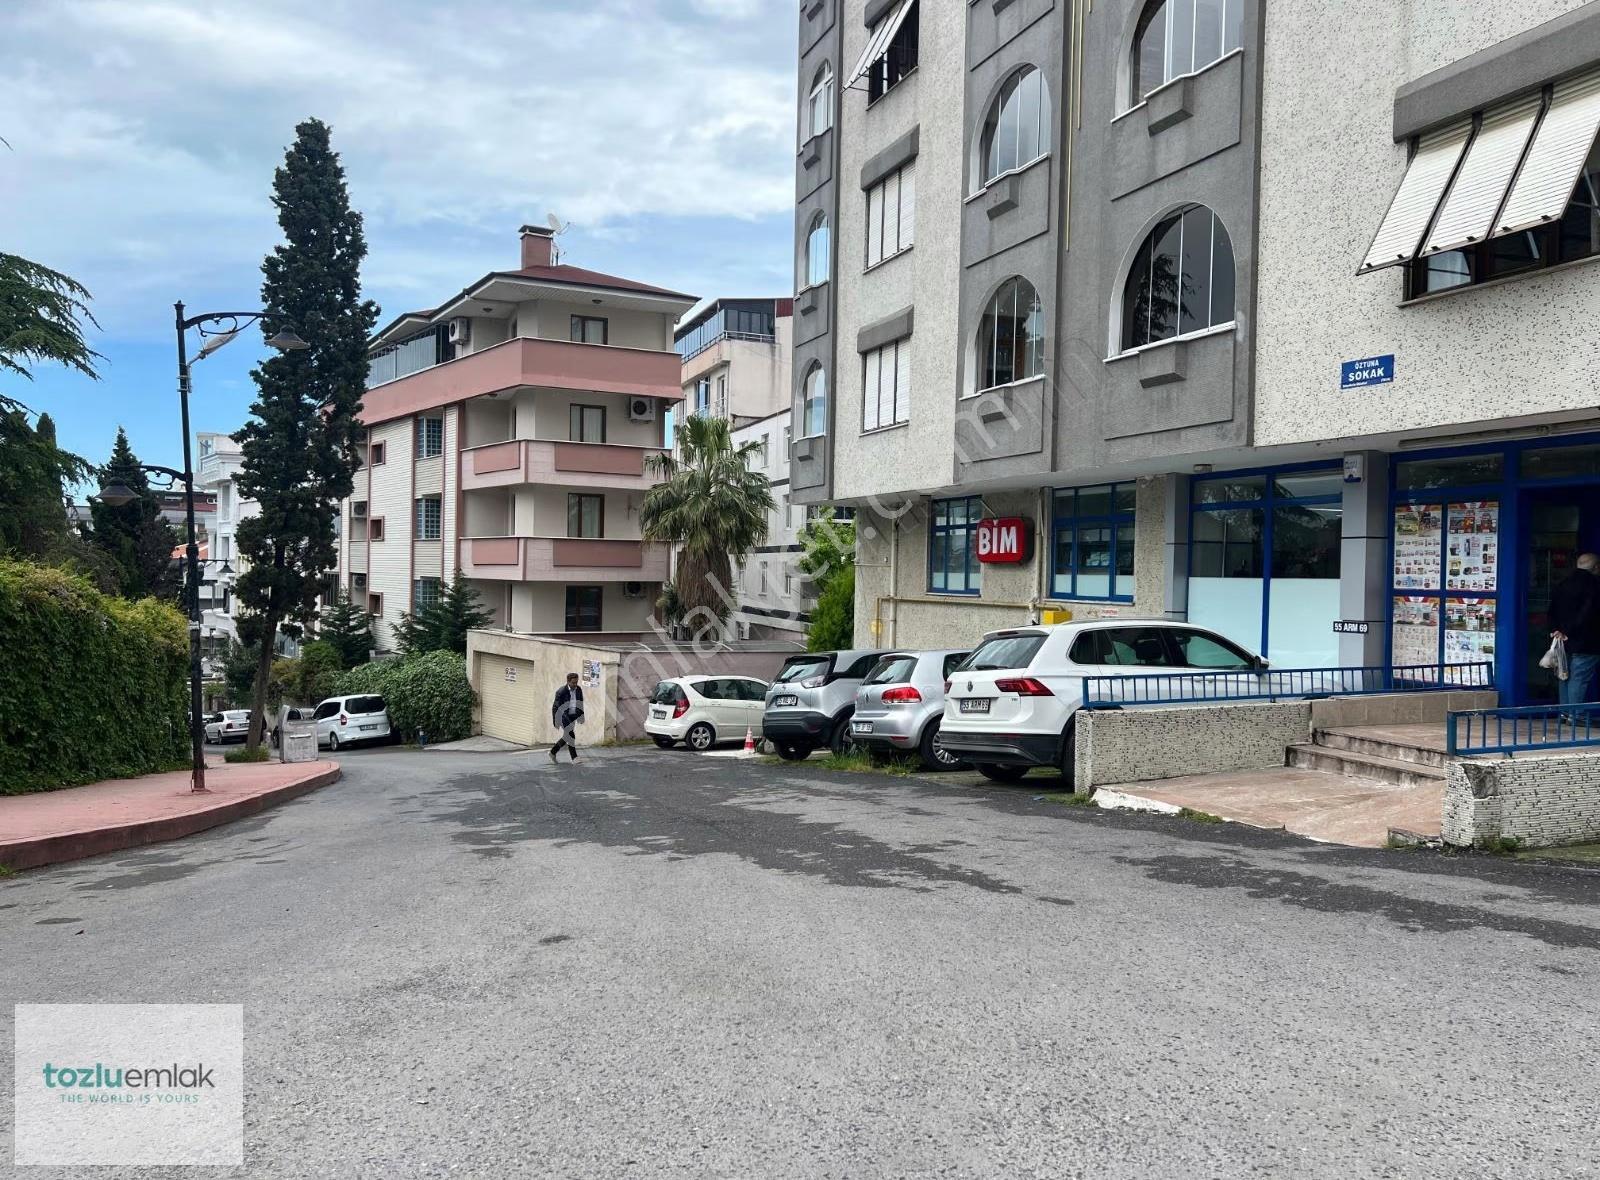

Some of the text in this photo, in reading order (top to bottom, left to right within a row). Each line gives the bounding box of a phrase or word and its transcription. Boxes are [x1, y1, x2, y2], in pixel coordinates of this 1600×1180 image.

[1349, 367, 1384, 381] SOKAK
[978, 519, 1017, 555] BİM
[1335, 623, 1342, 631] 55
[1359, 623, 1368, 632] 69
